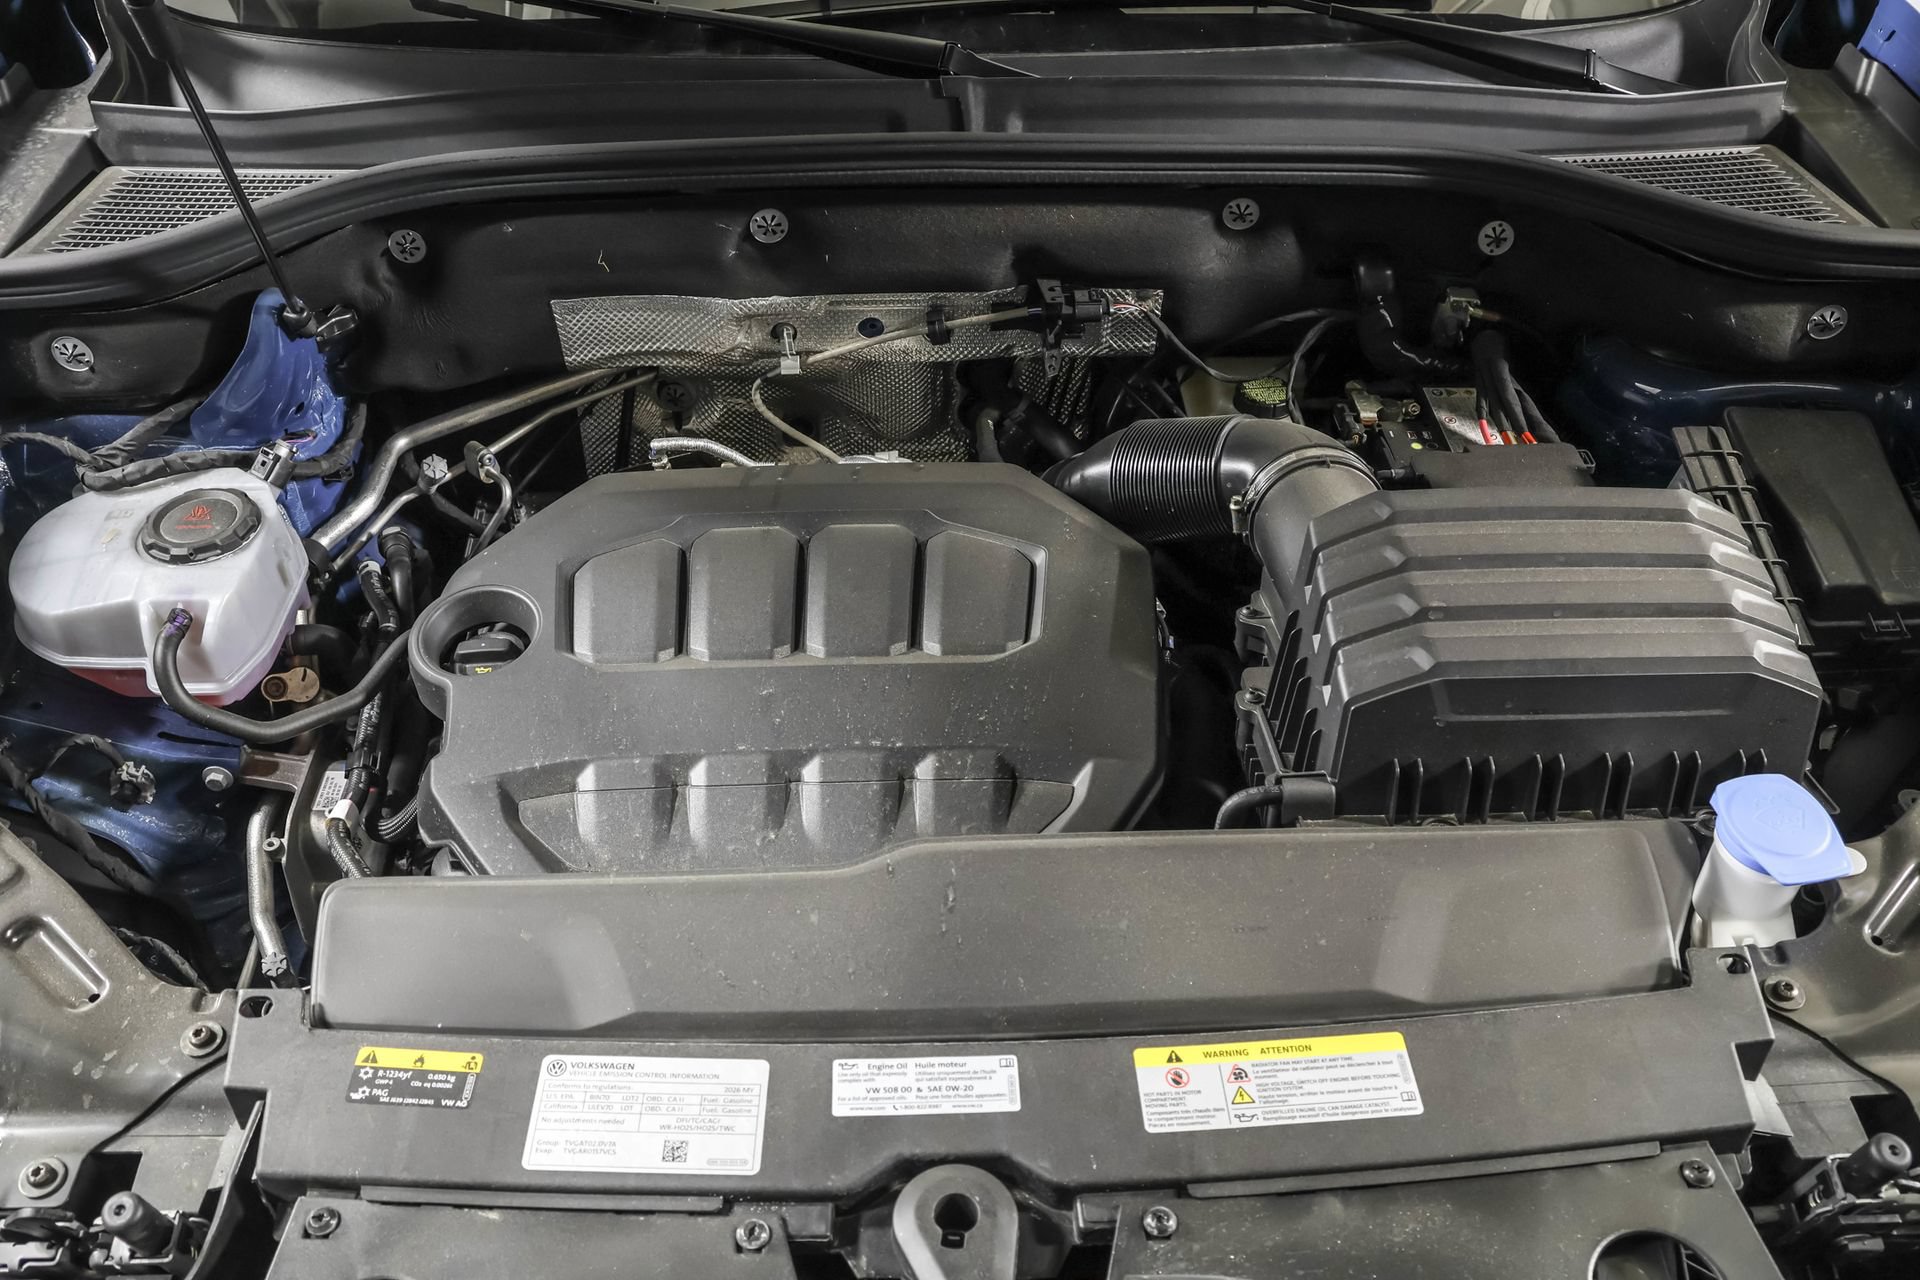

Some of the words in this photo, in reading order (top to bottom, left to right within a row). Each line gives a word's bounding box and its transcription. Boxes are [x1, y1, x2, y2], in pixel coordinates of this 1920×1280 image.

[1202, 1049, 1249, 1059] WARNING
[1260, 1045, 1312, 1055] ATTENTION
[570, 1062, 635, 1070] VOLKSWAGEN
[377, 1070, 413, 1080] R-1234yf
[447, 1074, 456, 1083] kg
[635, 1071, 667, 1079] CONTROL
[669, 1072, 720, 1080] INFORMATION
[371, 1088, 389, 1097] PAG
[945, 1084, 974, 1092] 0W-20
[455, 1099, 468, 1107] AG
